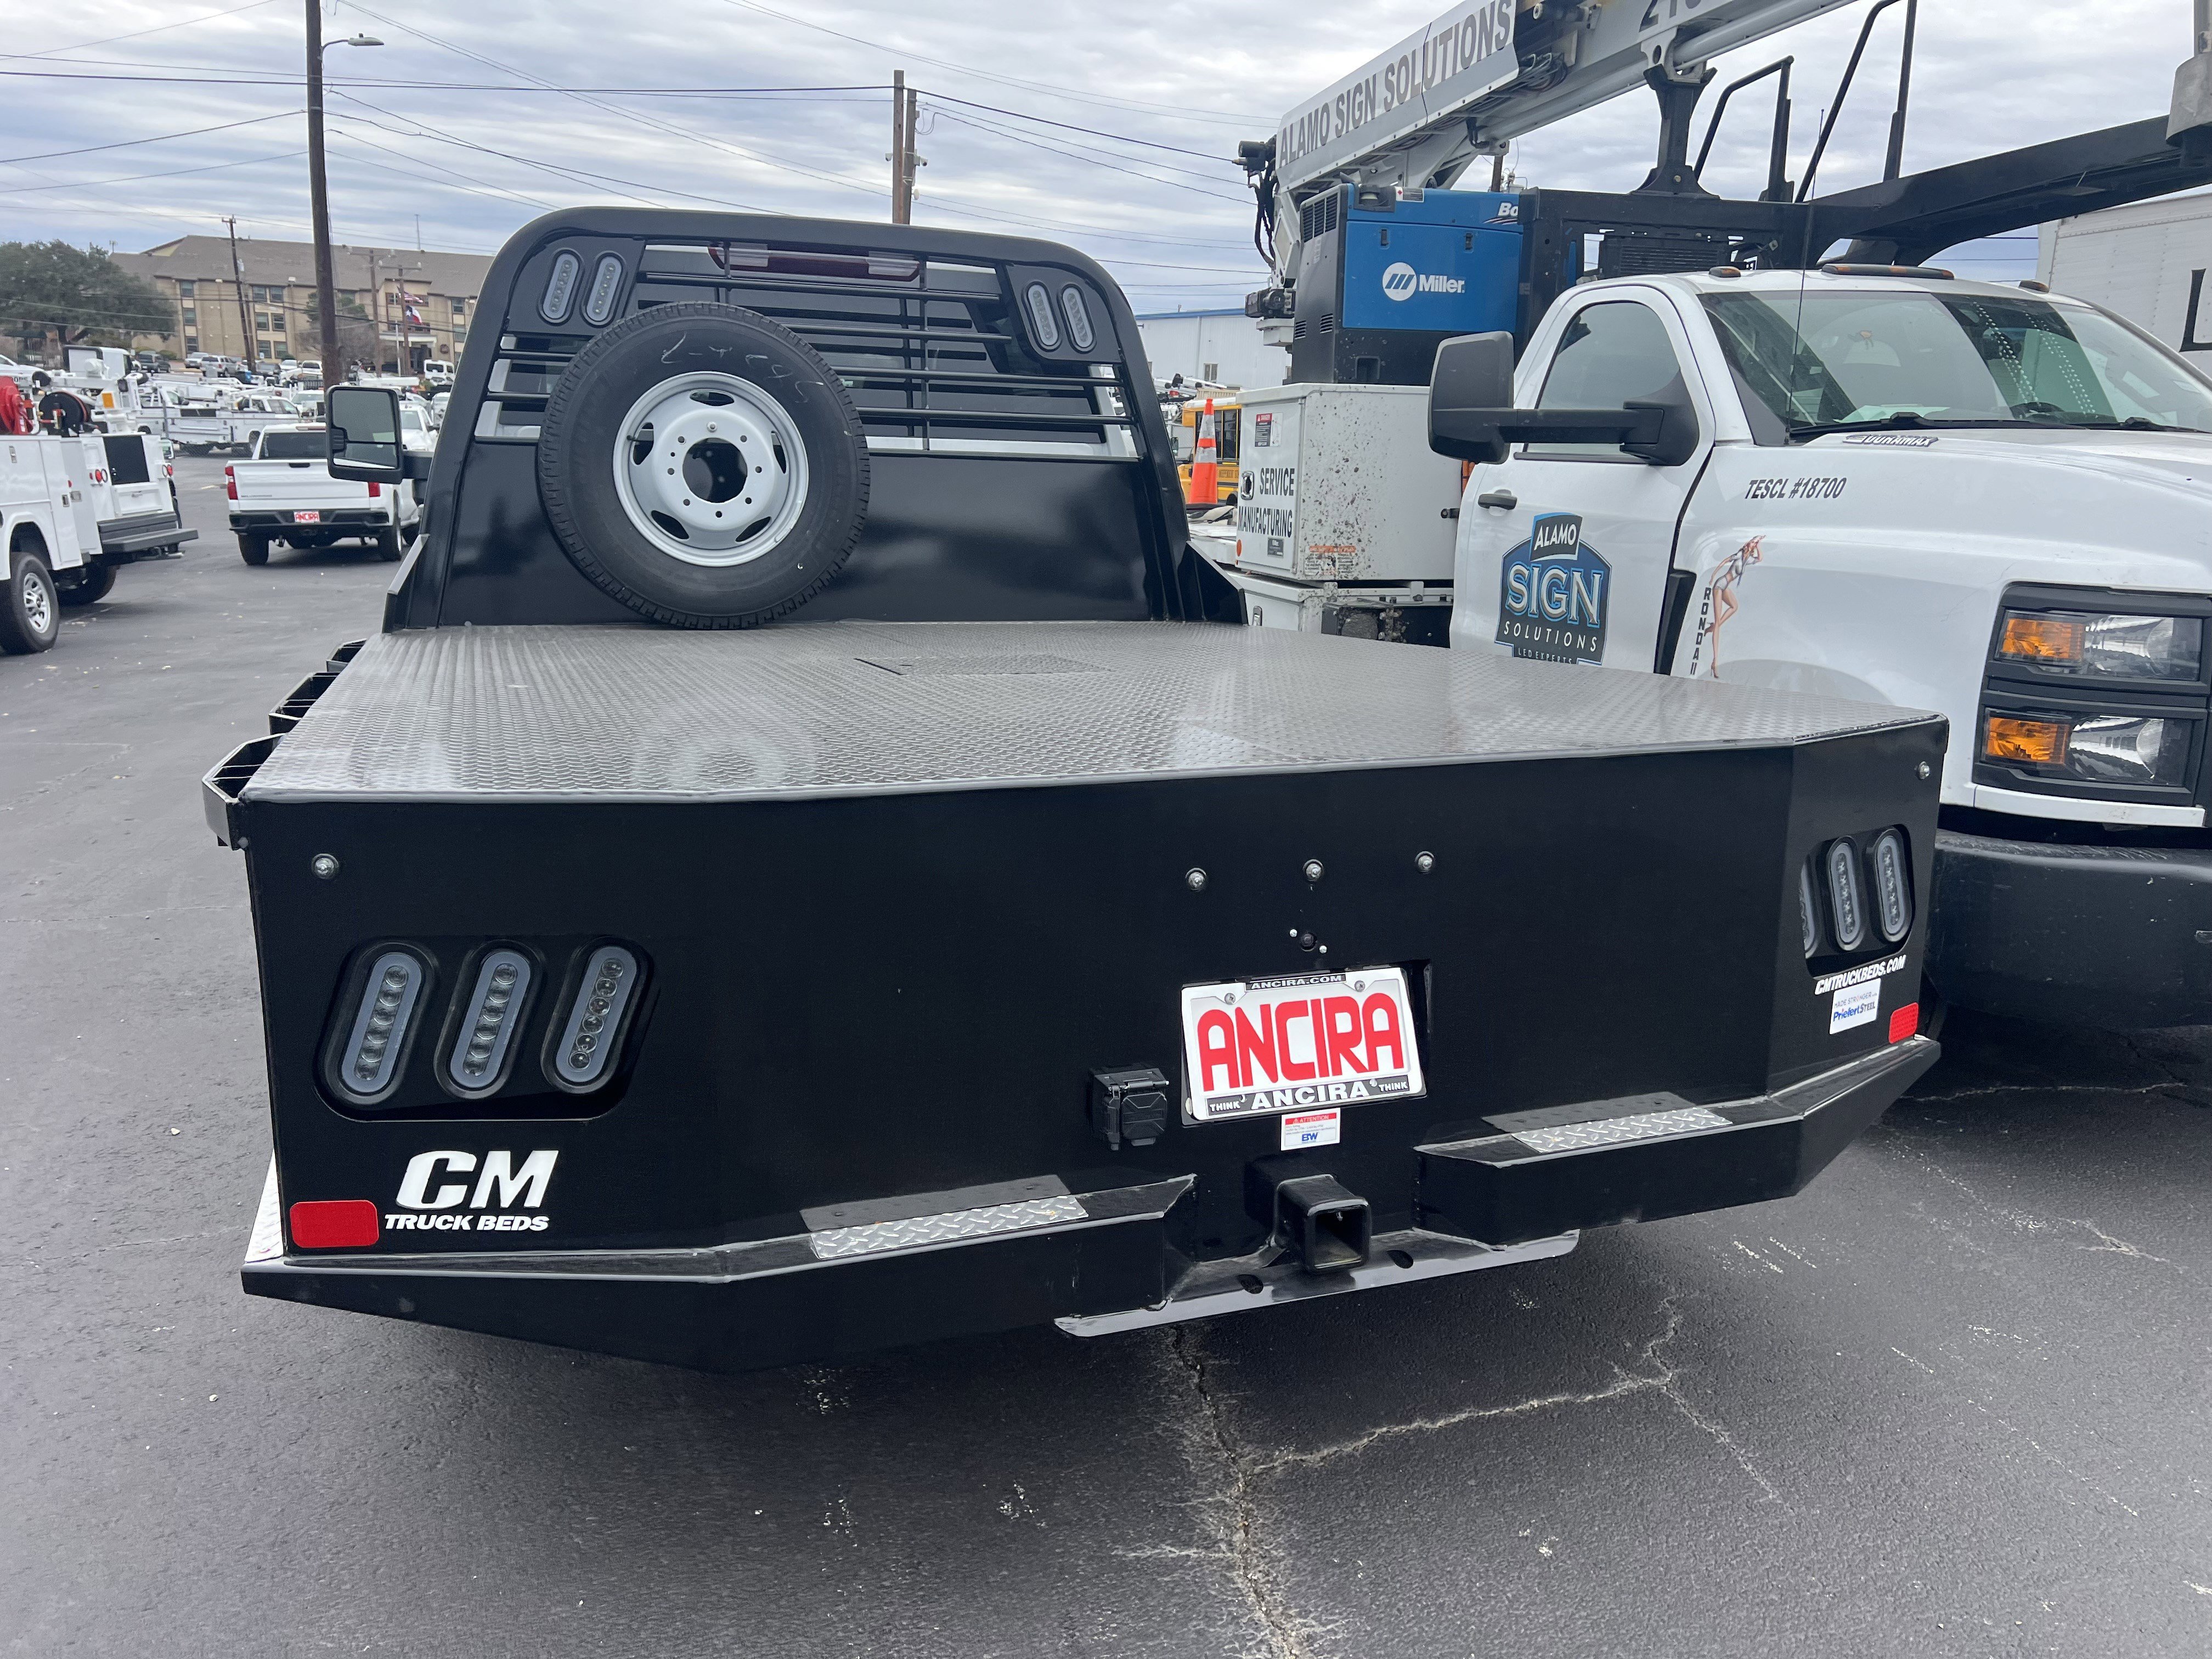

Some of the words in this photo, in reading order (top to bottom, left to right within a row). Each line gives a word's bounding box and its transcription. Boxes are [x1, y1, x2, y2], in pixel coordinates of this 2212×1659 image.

[1279, 102, 1330, 168] ALAMO
[1335, 74, 1376, 138] SIGN
[1384, 0, 1511, 112] SOLUTIONS
[1863, 435, 1937, 447] DURAMAX
[1260, 467, 1295, 496] SERVICE
[1745, 478, 1788, 499] TESCL
[1788, 477, 1847, 499] #18700
[1238, 506, 1293, 538] MANUFACTURING
[1534, 523, 1577, 551] ALAMO
[1506, 562, 1603, 628] SIGN
[1504, 620, 1598, 652] SOLUTIONS
[1518, 647, 1532, 657] LED
[1251, 975, 1342, 990] ANCIRA.COM
[1814, 954, 1906, 995] CMTRUCKBEDS.COM
[1833, 999, 1847, 1008] MADE
[1197, 992, 1404, 1092] ANCIRA
[1210, 1101, 1241, 1111] THINK
[1251, 1081, 1370, 1110] ANCIRA
[1379, 1081, 1408, 1092] THINK
[1299, 1115, 1329, 1123] ATTENTION
[396, 1150, 559, 1210] CM
[385, 1214, 473, 1230] TRUCK
[476, 1215, 550, 1231] BEDS
